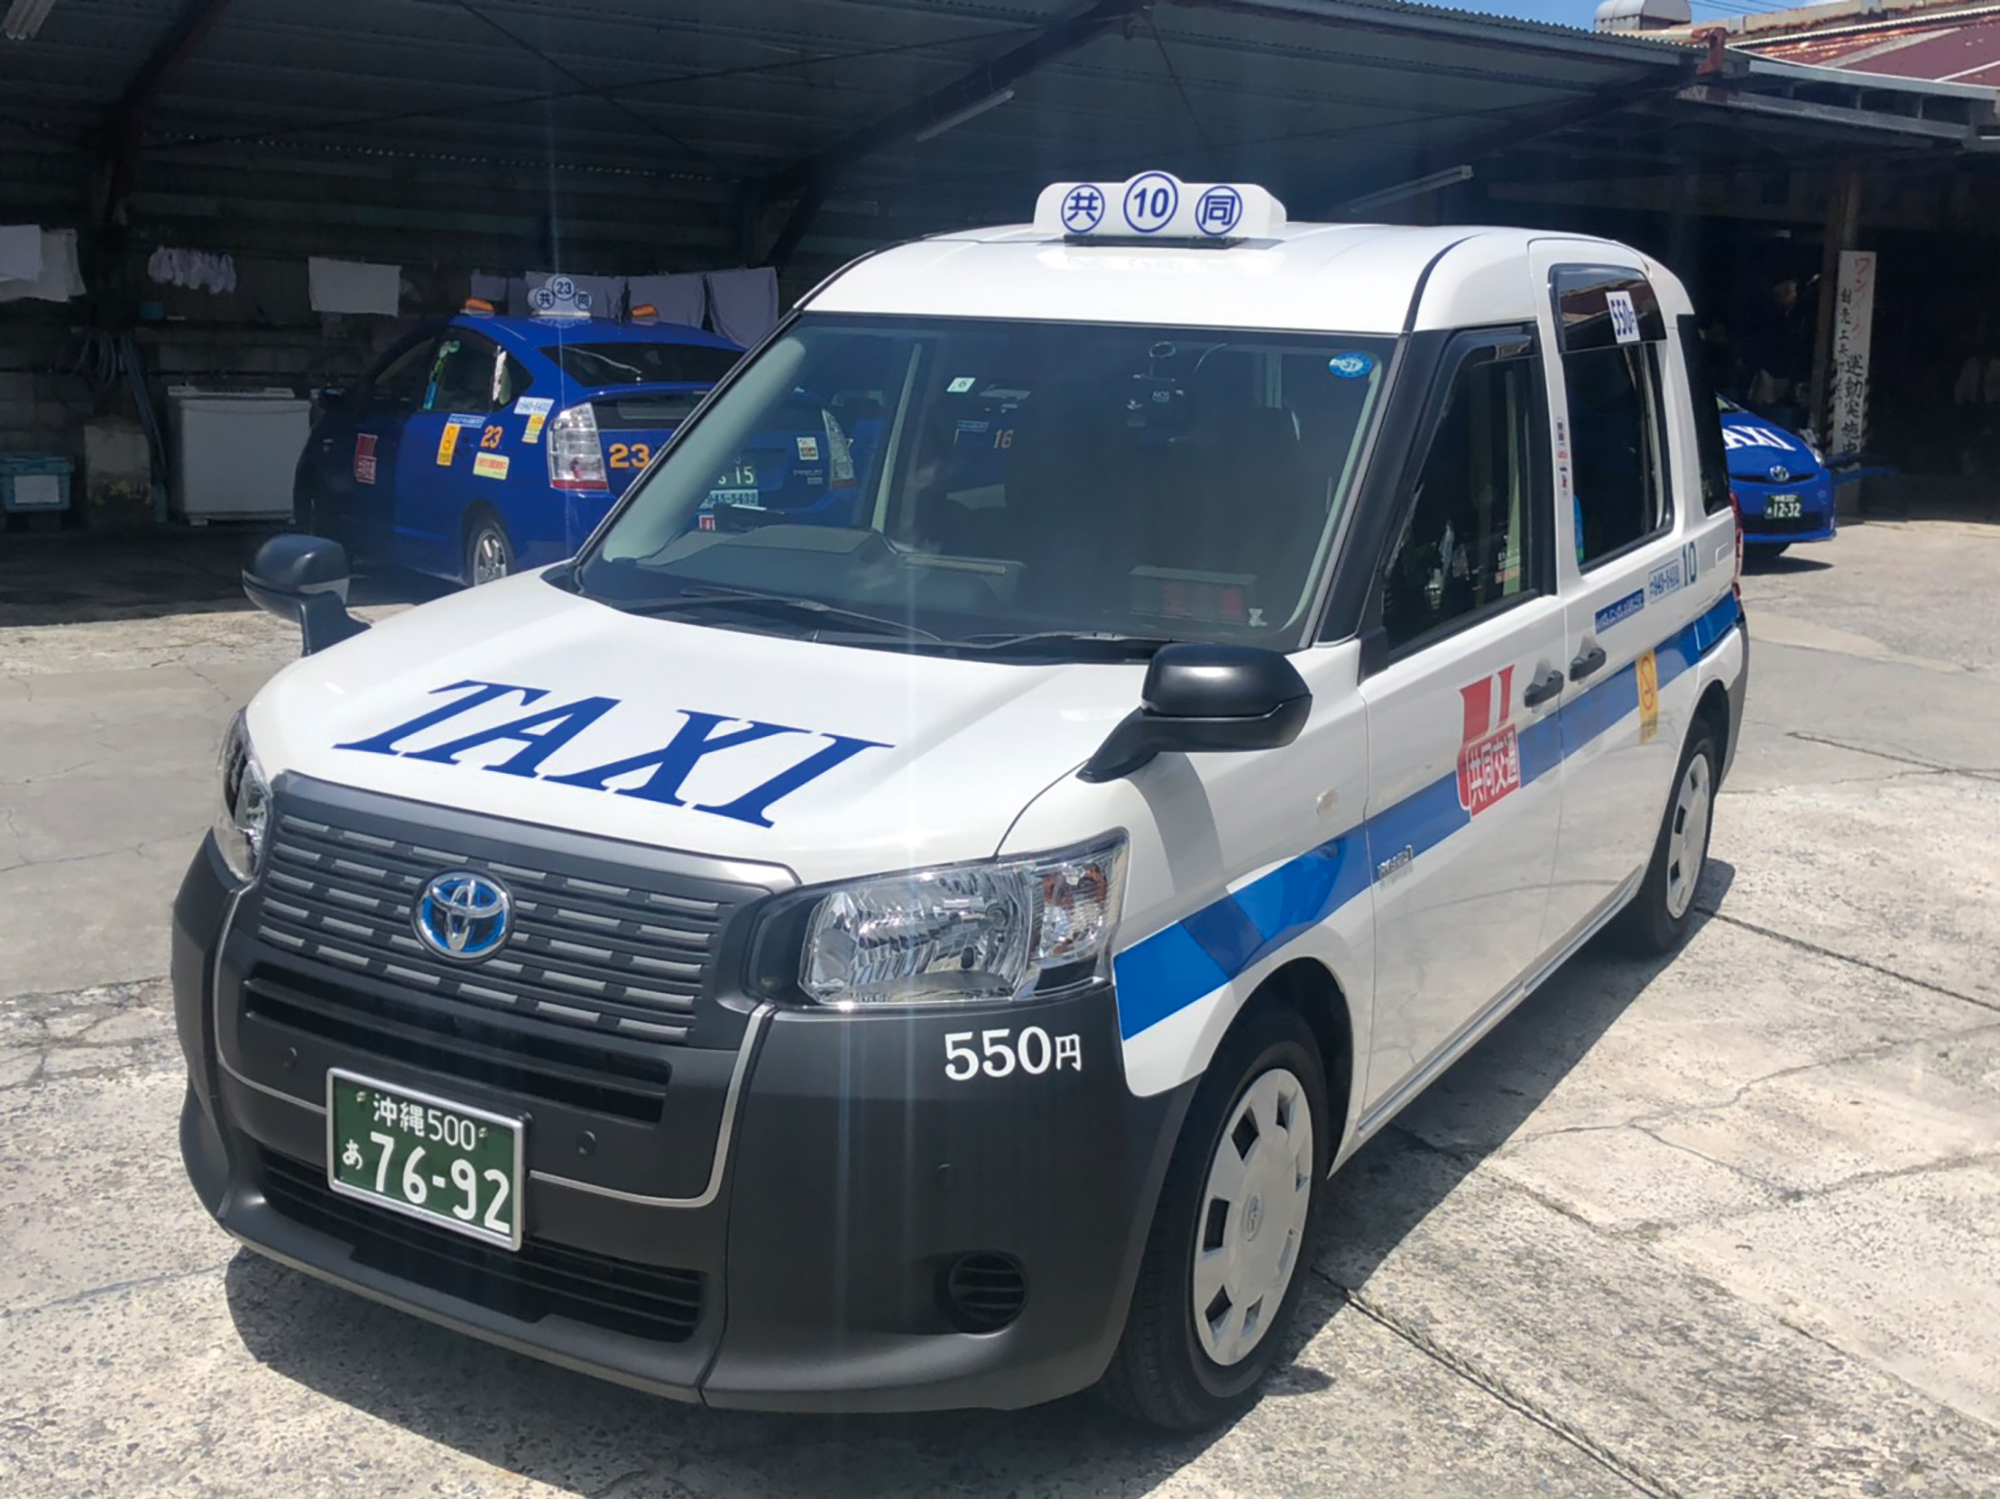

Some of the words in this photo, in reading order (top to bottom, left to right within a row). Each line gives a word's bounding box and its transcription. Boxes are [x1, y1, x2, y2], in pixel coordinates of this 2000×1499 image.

[1066, 191, 1099, 222] 共
[1133, 187, 1170, 219] 10
[1201, 195, 1237, 226] 同
[556, 282, 572, 295] 23
[480, 424, 504, 450] 23
[608, 443, 651, 469] 23
[993, 429, 1015, 449] 16
[1721, 425, 1797, 452] AXI
[1682, 540, 1697, 588] 10
[331, 679, 897, 829] TAXI
[1470, 731, 1519, 808] 共同交通
[944, 1025, 1082, 1081] 550円
[372, 1092, 476, 1152] 沖縄500
[342, 1138, 364, 1171] あ
[369, 1130, 511, 1235] 76-92
